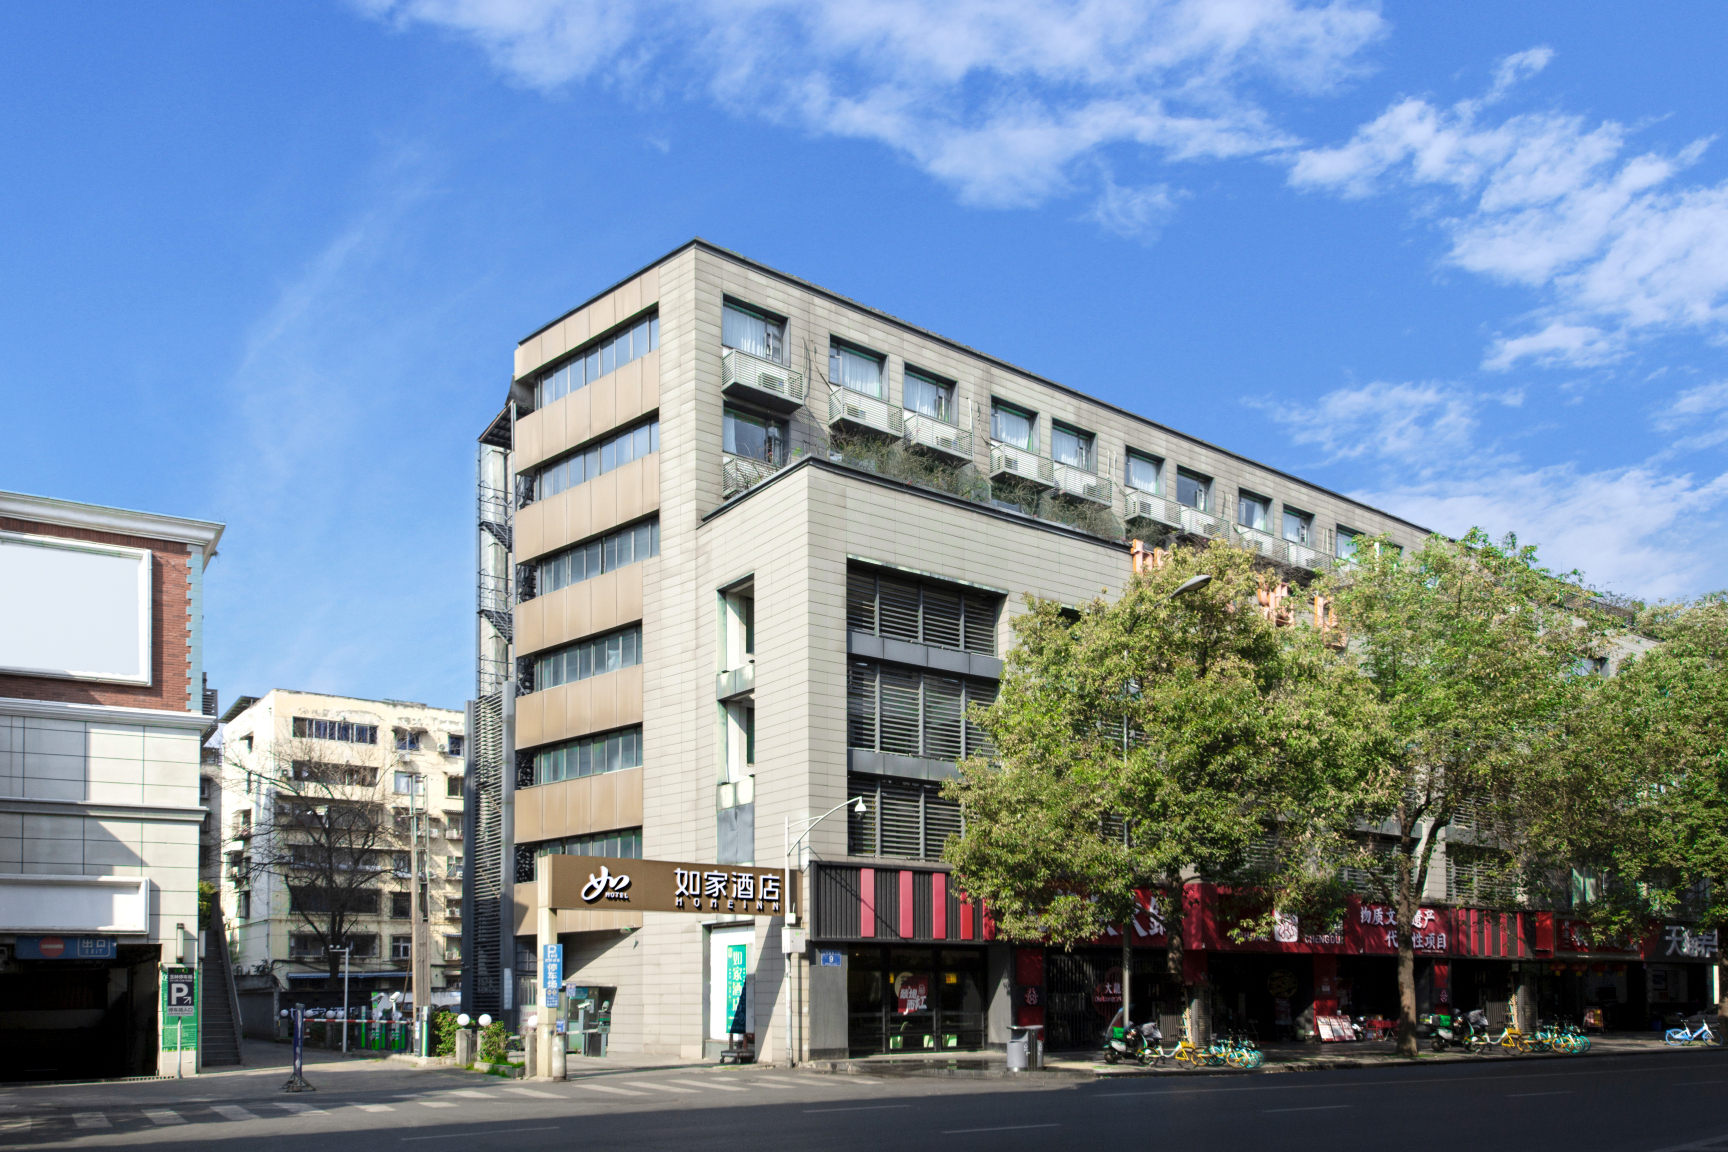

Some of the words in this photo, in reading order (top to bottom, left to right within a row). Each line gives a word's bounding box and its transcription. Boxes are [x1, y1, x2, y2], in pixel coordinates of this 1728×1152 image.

[674, 867, 779, 900] 如家酒店
[605, 891, 629, 899] HOTEL
[1360, 906, 1435, 929] 物质文遗产
[82, 939, 106, 948] 出口
[1304, 934, 1341, 944] CHENGDU
[1385, 930, 1446, 949] 代性项目
[547, 945, 557, 959] P
[547, 963, 558, 988] 停车场
[171, 983, 189, 1005] P
